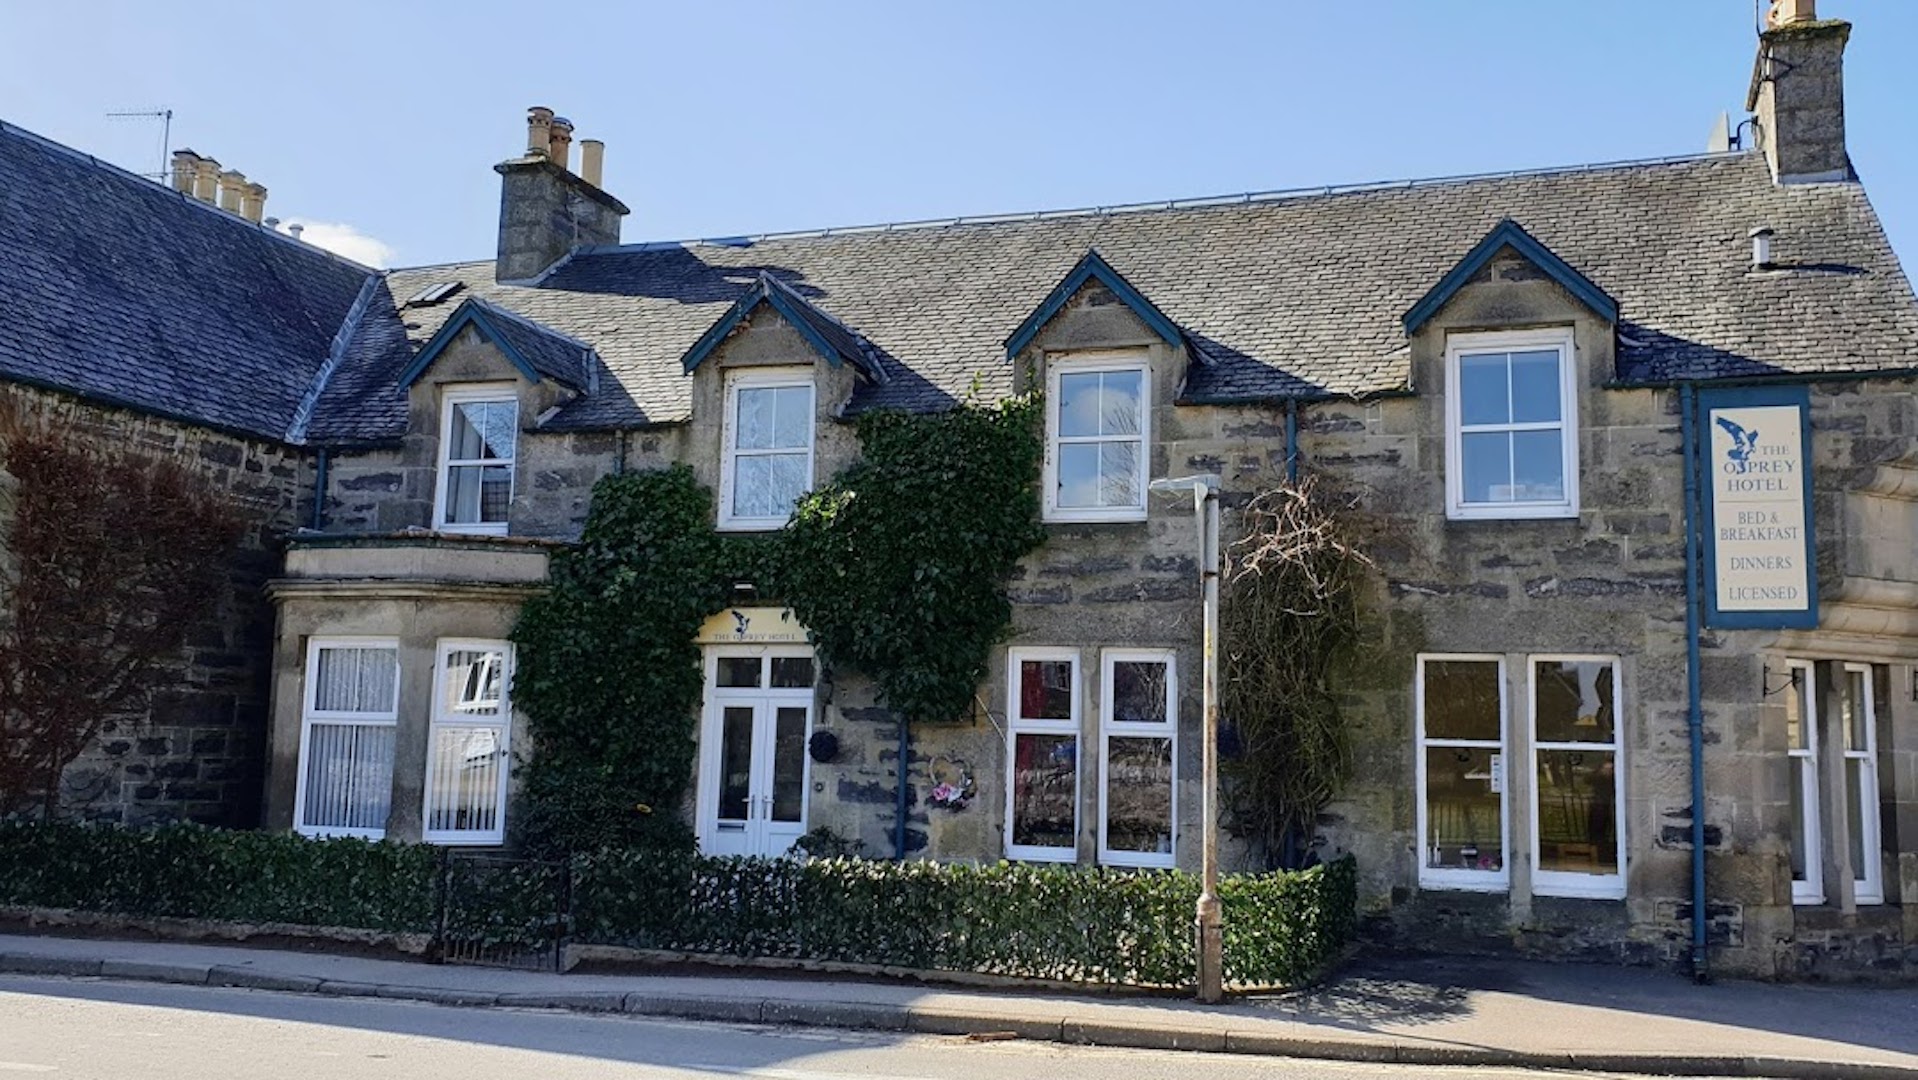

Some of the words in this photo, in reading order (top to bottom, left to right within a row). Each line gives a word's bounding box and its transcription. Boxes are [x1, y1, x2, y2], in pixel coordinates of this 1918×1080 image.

[1761, 445, 1790, 456] THE
[1728, 478, 1789, 492] HOTEL
[1738, 511, 1766, 525] BED
[1770, 511, 1778, 525] &
[1720, 527, 1797, 541] BREAKFAST
[1731, 555, 1792, 570] DINNERS
[1729, 586, 1798, 600] LICENSED
